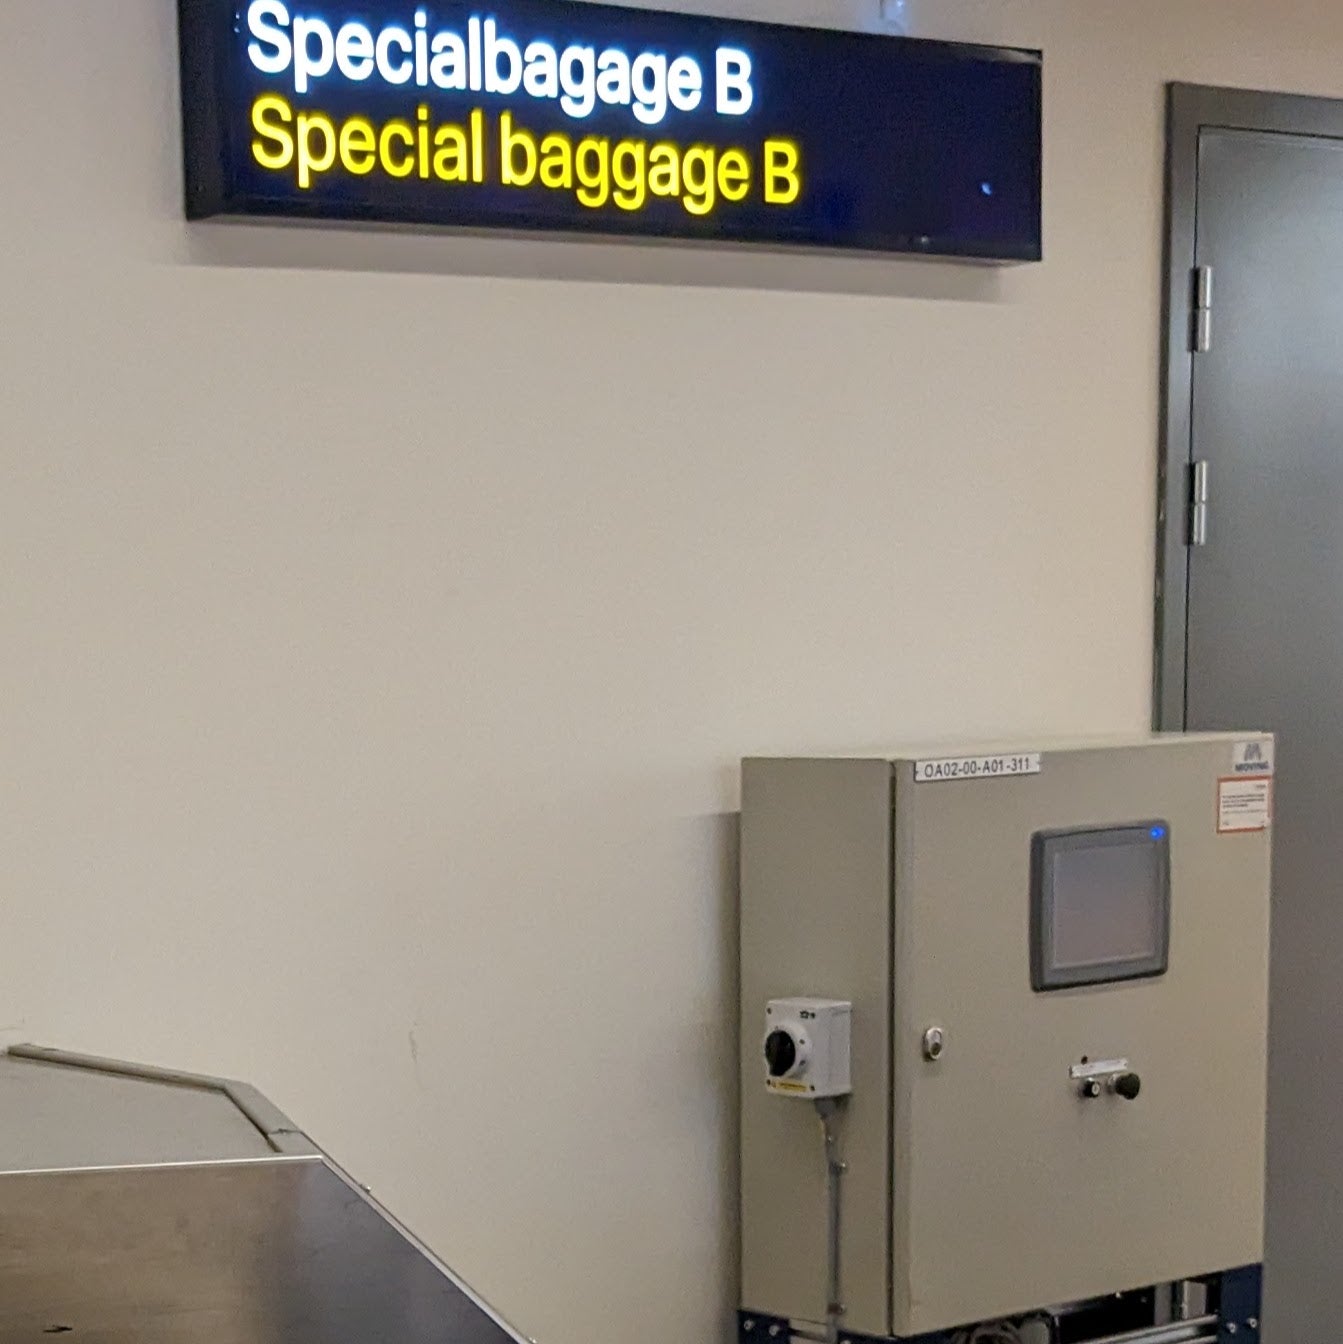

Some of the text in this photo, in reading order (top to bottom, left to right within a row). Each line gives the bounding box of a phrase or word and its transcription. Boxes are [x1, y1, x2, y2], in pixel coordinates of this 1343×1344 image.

[247, 0, 753, 124] Specialbagage B
[251, 96, 800, 214] Special baggage B
